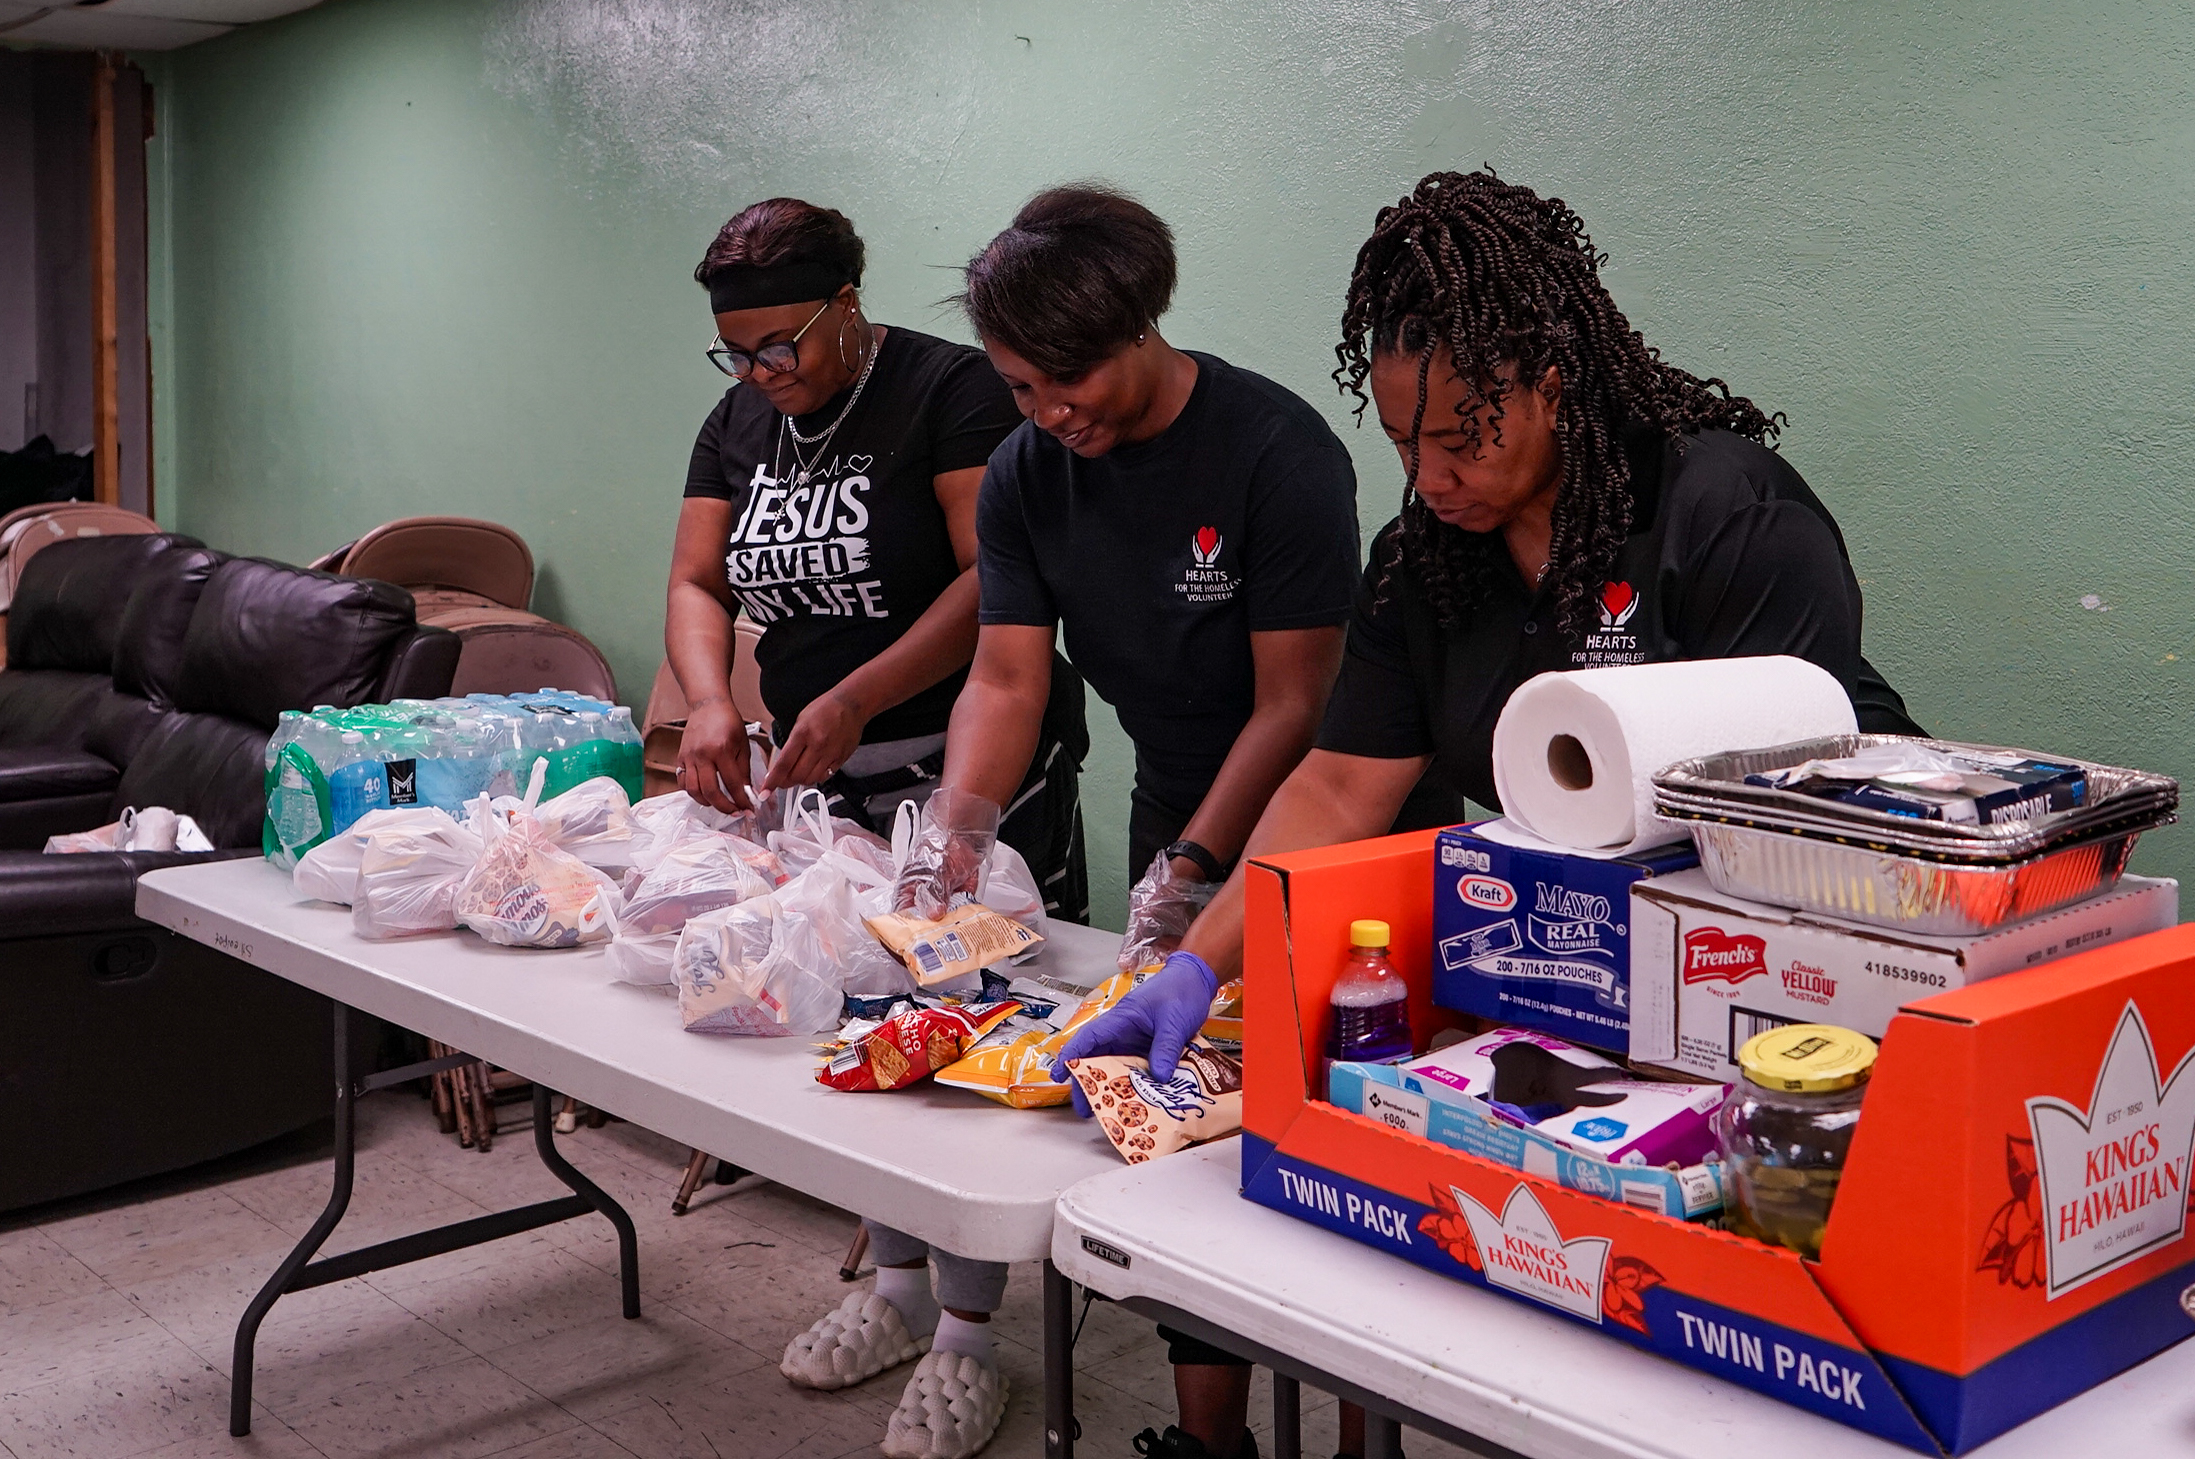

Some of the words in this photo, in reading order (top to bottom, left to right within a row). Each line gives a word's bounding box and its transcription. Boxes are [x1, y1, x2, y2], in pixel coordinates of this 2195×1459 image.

[730, 463, 871, 543] JESUS
[735, 543, 849, 582] SAVED
[1185, 569, 1228, 582] HEARTS
[1174, 583, 1188, 592] FOR
[1189, 583, 1203, 593] THE
[732, 586, 794, 623] MY
[793, 580, 889, 618] LIFE
[1586, 634, 1637, 650] HEARTS
[1571, 652, 1587, 663] FOR
[1588, 652, 1603, 662] THE
[1603, 652, 1645, 663] HOMELESS
[363, 777, 381, 793] 40
[1472, 884, 1502, 902] Kraft
[1535, 881, 1611, 924] MAYO
[1547, 923, 1600, 940] REAL
[1547, 938, 1600, 949] MAYONNAISE
[1690, 943, 1756, 970] French's
[1497, 960, 1513, 972] 200
[1520, 962, 1541, 975] 7/16
[1542, 964, 1556, 976] OZ
[1557, 965, 1603, 984] POUCHES
[1791, 960, 1826, 976] Classic
[1865, 961, 1947, 988] 418539902
[1706, 985, 1725, 999] SINCE
[1781, 969, 1836, 998] YELLOW
[1786, 990, 1830, 1006] MUSTARD
[1549, 1004, 1572, 1017] POUCHES
[1204, 1059, 1218, 1077] CHIP
[1431, 1069, 1459, 1084] Large
[1382, 1099, 1406, 1114] Member's
[1406, 1108, 1421, 1118] Mark
[2106, 1108, 2123, 1125] EST
[1383, 1112, 1406, 1129] FOOD
[2084, 1122, 2161, 1188] KING'S
[1277, 1167, 1341, 1218] TWIN
[1345, 1190, 1413, 1246] PACK
[2058, 1157, 2181, 1244] HAWAIIAN
[1086, 1240, 1125, 1265] LIFETIME
[1503, 1233, 1568, 1271] KING'S
[1488, 1245, 1592, 1300] HAWAIIAN
[1676, 1310, 1765, 1373] TWIN
[1773, 1343, 1867, 1411] PACK
